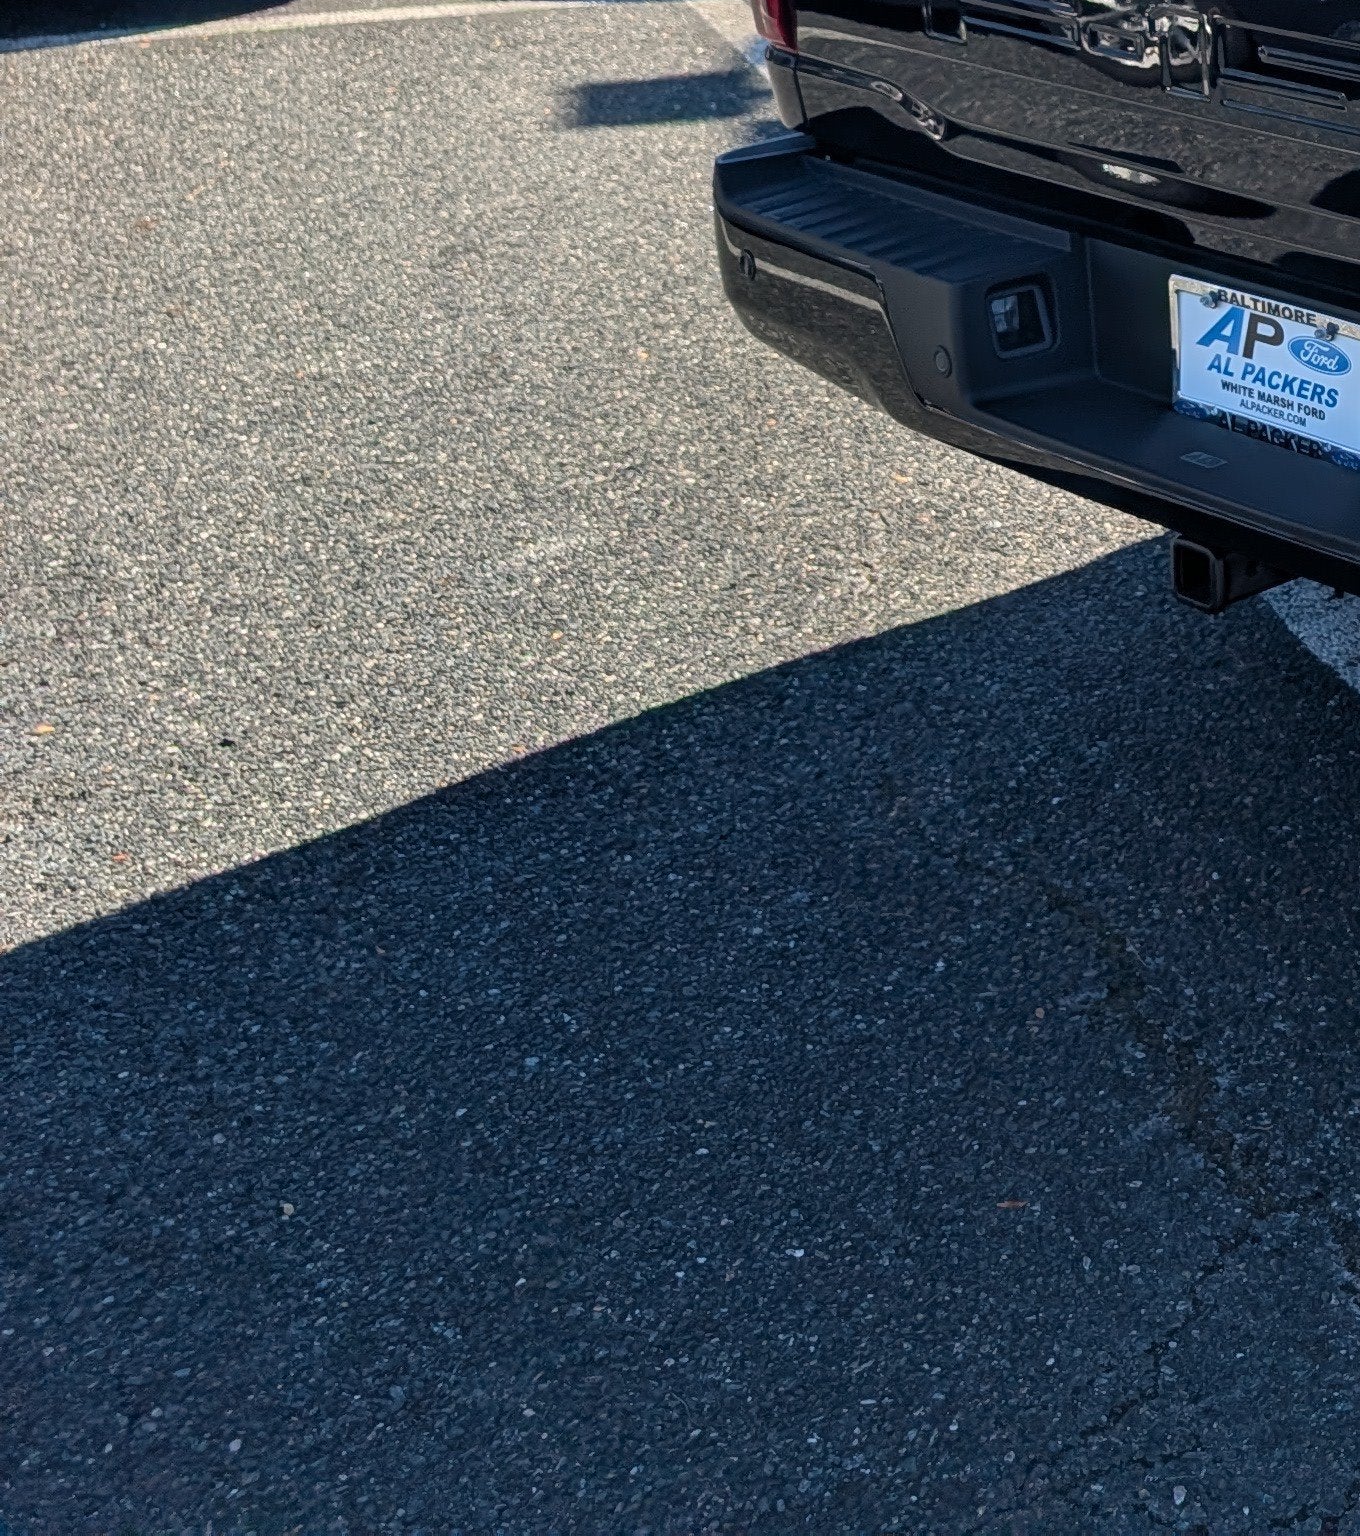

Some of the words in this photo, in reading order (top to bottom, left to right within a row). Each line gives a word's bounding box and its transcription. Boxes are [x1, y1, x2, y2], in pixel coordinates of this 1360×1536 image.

[1218, 288, 1318, 328] BALTIMORE
[1196, 306, 1286, 360] AP
[1299, 339, 1340, 372] Ford
[1206, 353, 1237, 378] AL
[1240, 362, 1341, 409] PACKERS
[1220, 379, 1255, 401] WHITE
[1257, 390, 1295, 413] MARSH
[1296, 402, 1327, 421] FORD
[1239, 398, 1308, 428] ALPACKER.COM
